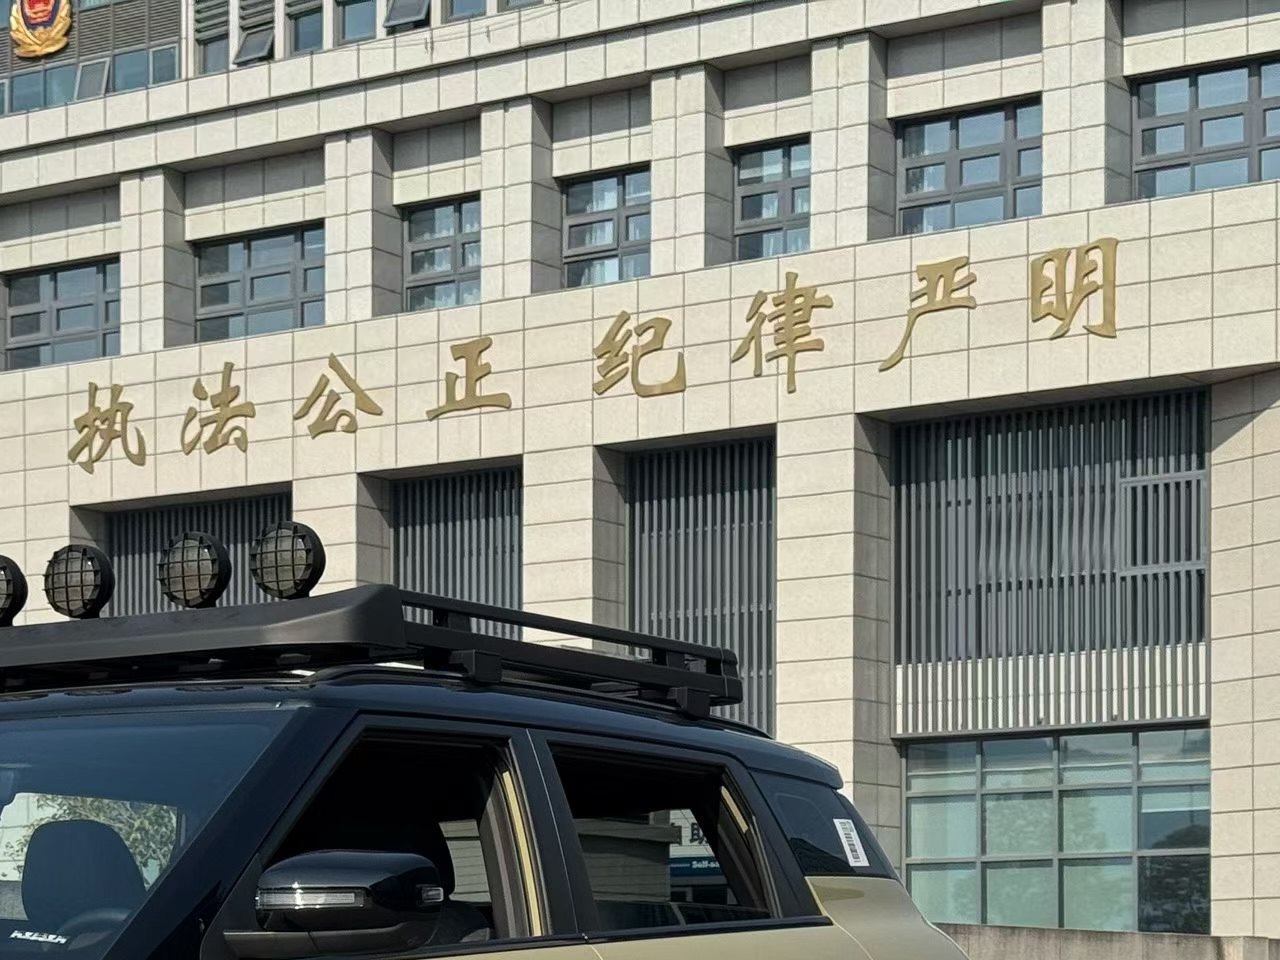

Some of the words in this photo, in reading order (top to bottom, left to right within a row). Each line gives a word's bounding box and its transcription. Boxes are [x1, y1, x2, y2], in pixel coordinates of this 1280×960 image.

[67, 337, 513, 474] 执法公正
[592, 237, 1119, 399] 纪律严明
